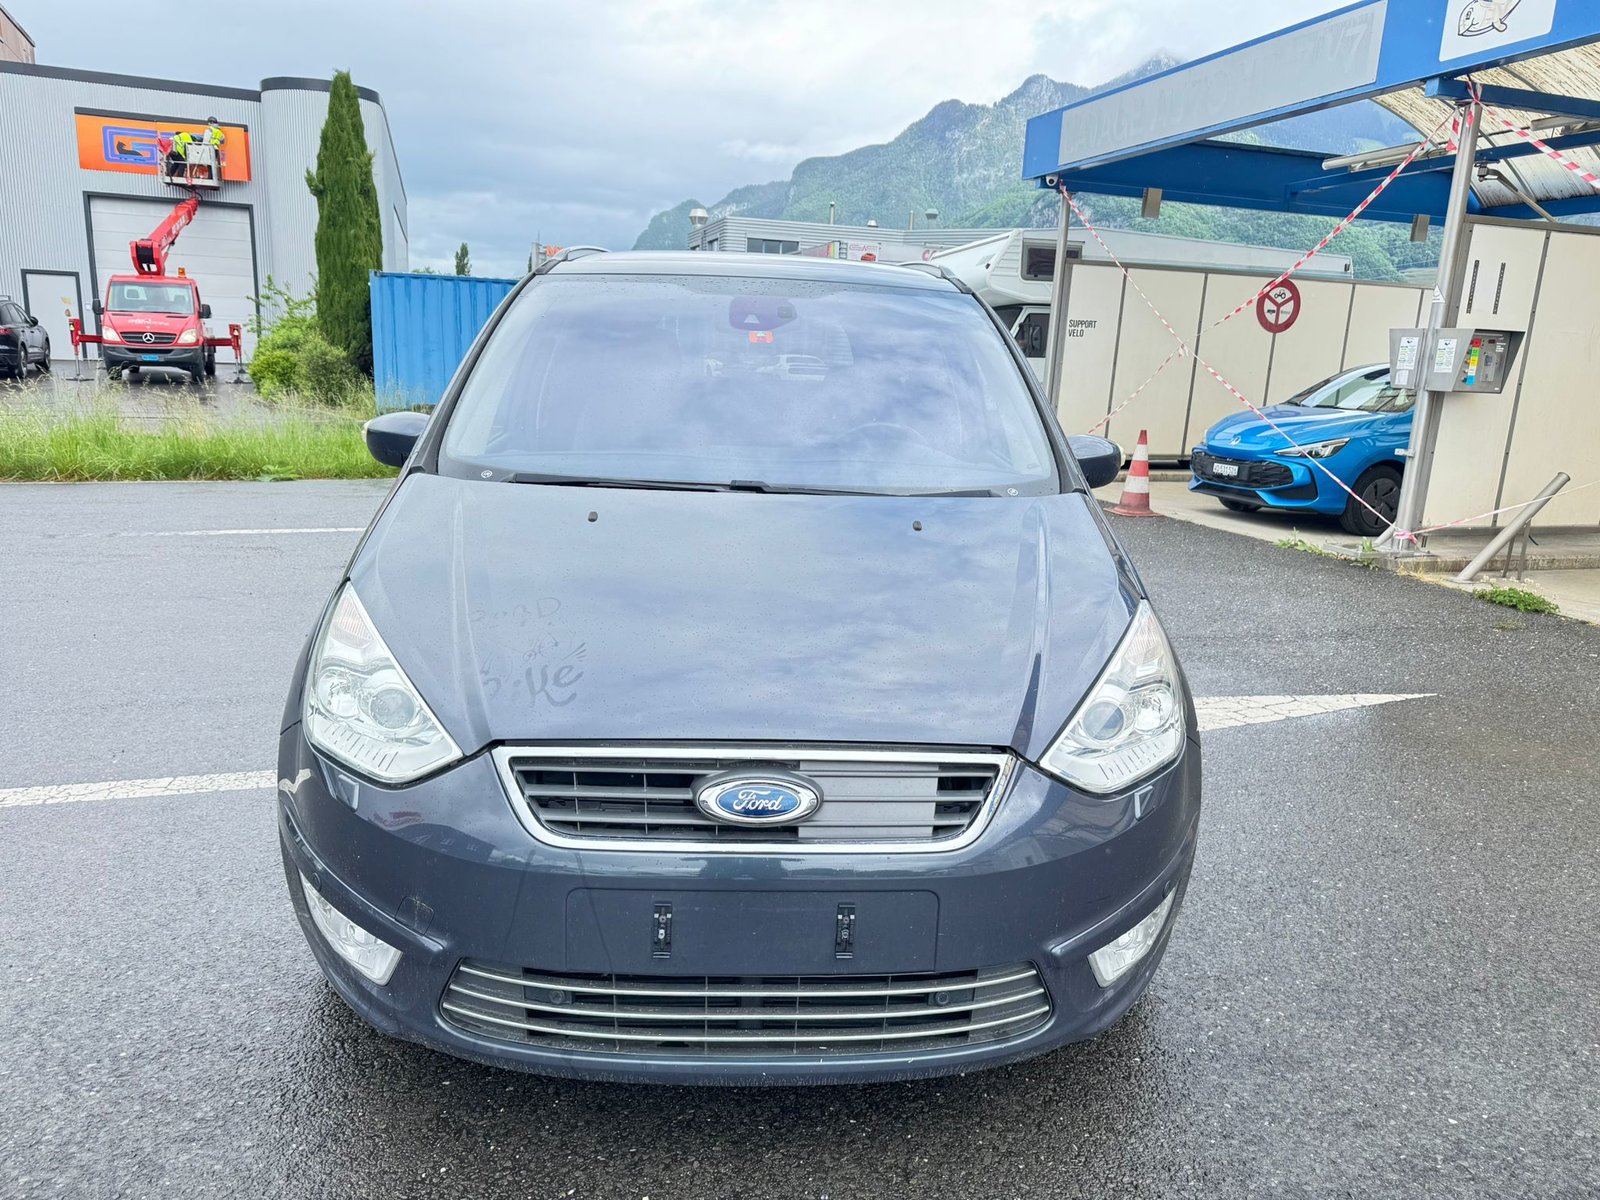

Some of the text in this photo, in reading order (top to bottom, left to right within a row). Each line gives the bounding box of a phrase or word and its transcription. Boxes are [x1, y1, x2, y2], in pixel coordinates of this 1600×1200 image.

[1069, 319, 1097, 328] SUPPORT
[1068, 329, 1084, 337] VELO
[732, 789, 784, 810] Ford
